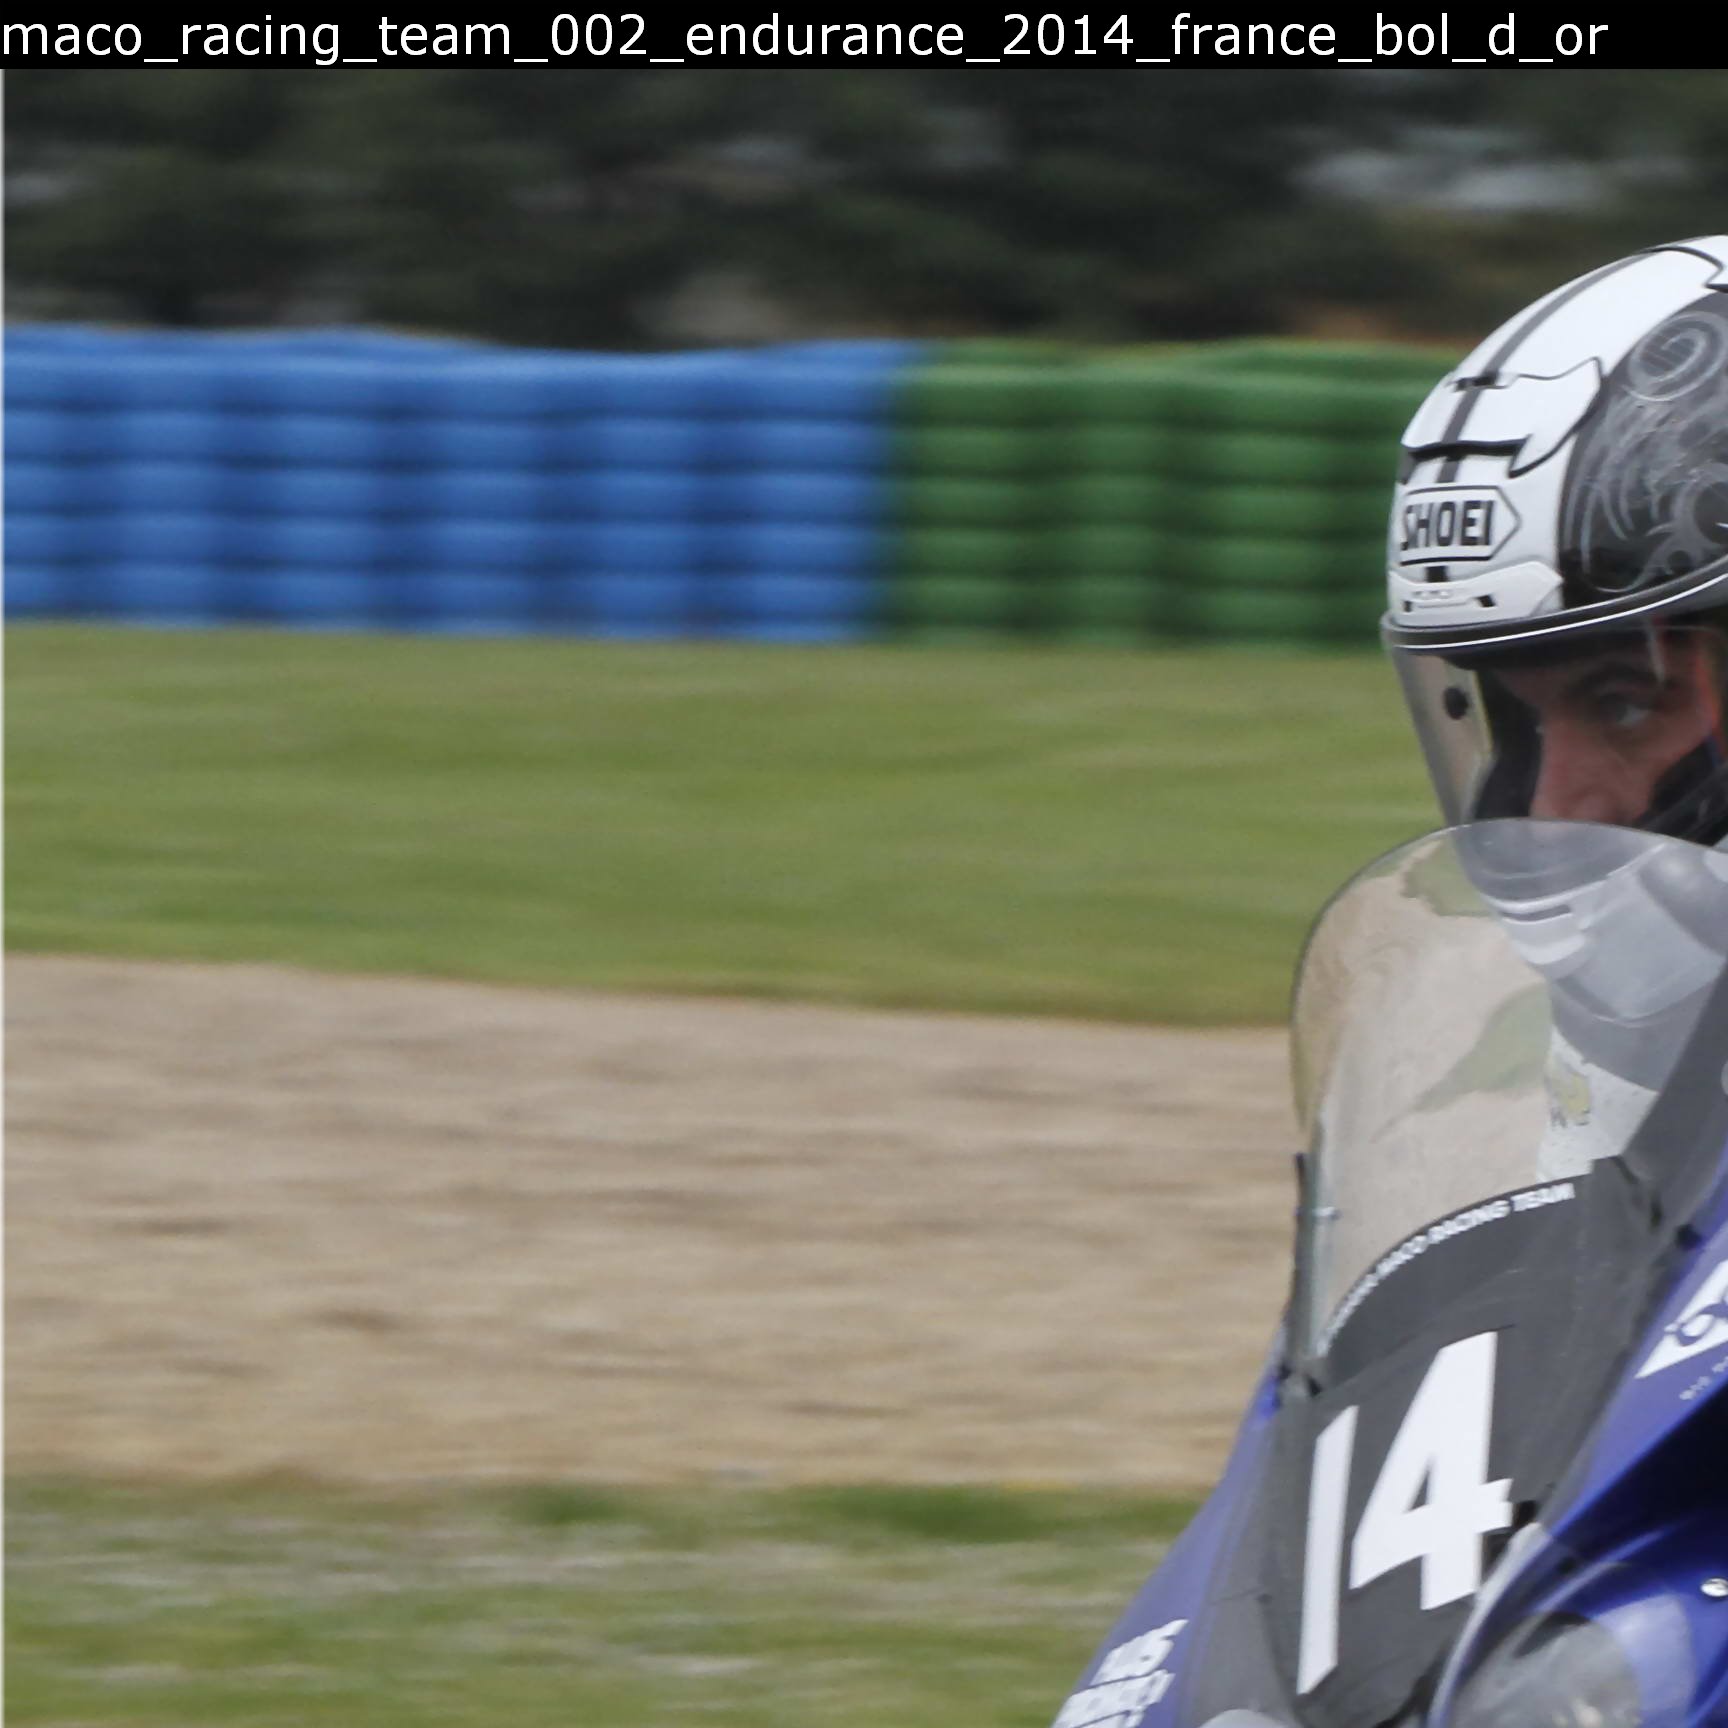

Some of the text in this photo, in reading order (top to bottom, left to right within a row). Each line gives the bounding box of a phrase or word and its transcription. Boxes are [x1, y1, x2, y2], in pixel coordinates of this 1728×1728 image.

[1400, 500, 1494, 551] SHOEI
[1509, 1181, 1577, 1213] TEAM
[1297, 1331, 1513, 1697] 14
